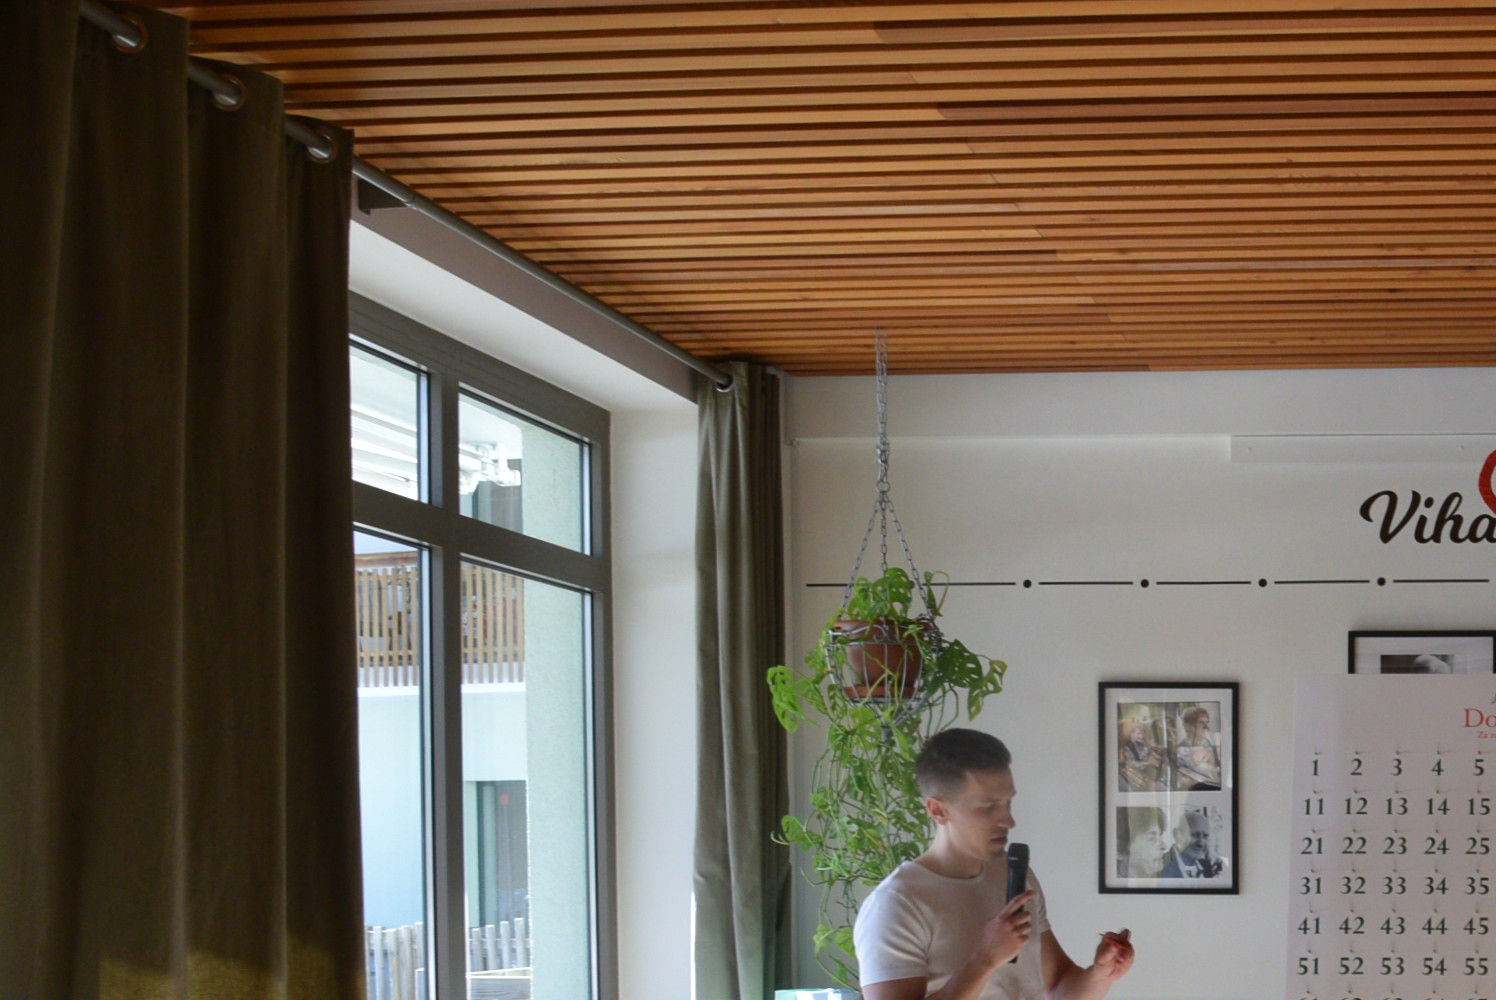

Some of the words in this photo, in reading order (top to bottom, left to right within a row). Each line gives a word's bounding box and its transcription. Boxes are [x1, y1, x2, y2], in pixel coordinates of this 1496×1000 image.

[1477, 731, 1489, 739] Za
[1312, 758, 1319, 777] 1
[1350, 757, 1363, 776] 2
[1392, 758, 1403, 777] 3
[1431, 758, 1445, 777] 4
[1473, 758, 1485, 777] 5
[1304, 797, 1324, 816] 11
[1345, 796, 1368, 815] 12
[1386, 797, 1409, 816] 13
[1426, 797, 1451, 816] 14
[1468, 797, 1491, 816] 15
[1300, 836, 1323, 855] 21
[1341, 836, 1367, 855] 22
[1382, 836, 1408, 855] 23
[1423, 836, 1450, 855] 24
[1465, 836, 1490, 856] 25
[1300, 876, 1322, 895] 31
[1341, 876, 1366, 895] 32
[1383, 876, 1407, 895] 33
[1424, 876, 1449, 895] 34
[1466, 876, 1490, 896] 35
[1297, 916, 1321, 935] 41
[1338, 915, 1365, 935] 42
[1379, 916, 1406, 935] 43
[1421, 917, 1449, 935] 44
[1463, 916, 1489, 936] 45
[1297, 956, 1320, 976] 51
[1338, 956, 1364, 976] 52
[1380, 956, 1405, 976] 53
[1422, 957, 1448, 976] 54
[1464, 957, 1489, 976] 55
